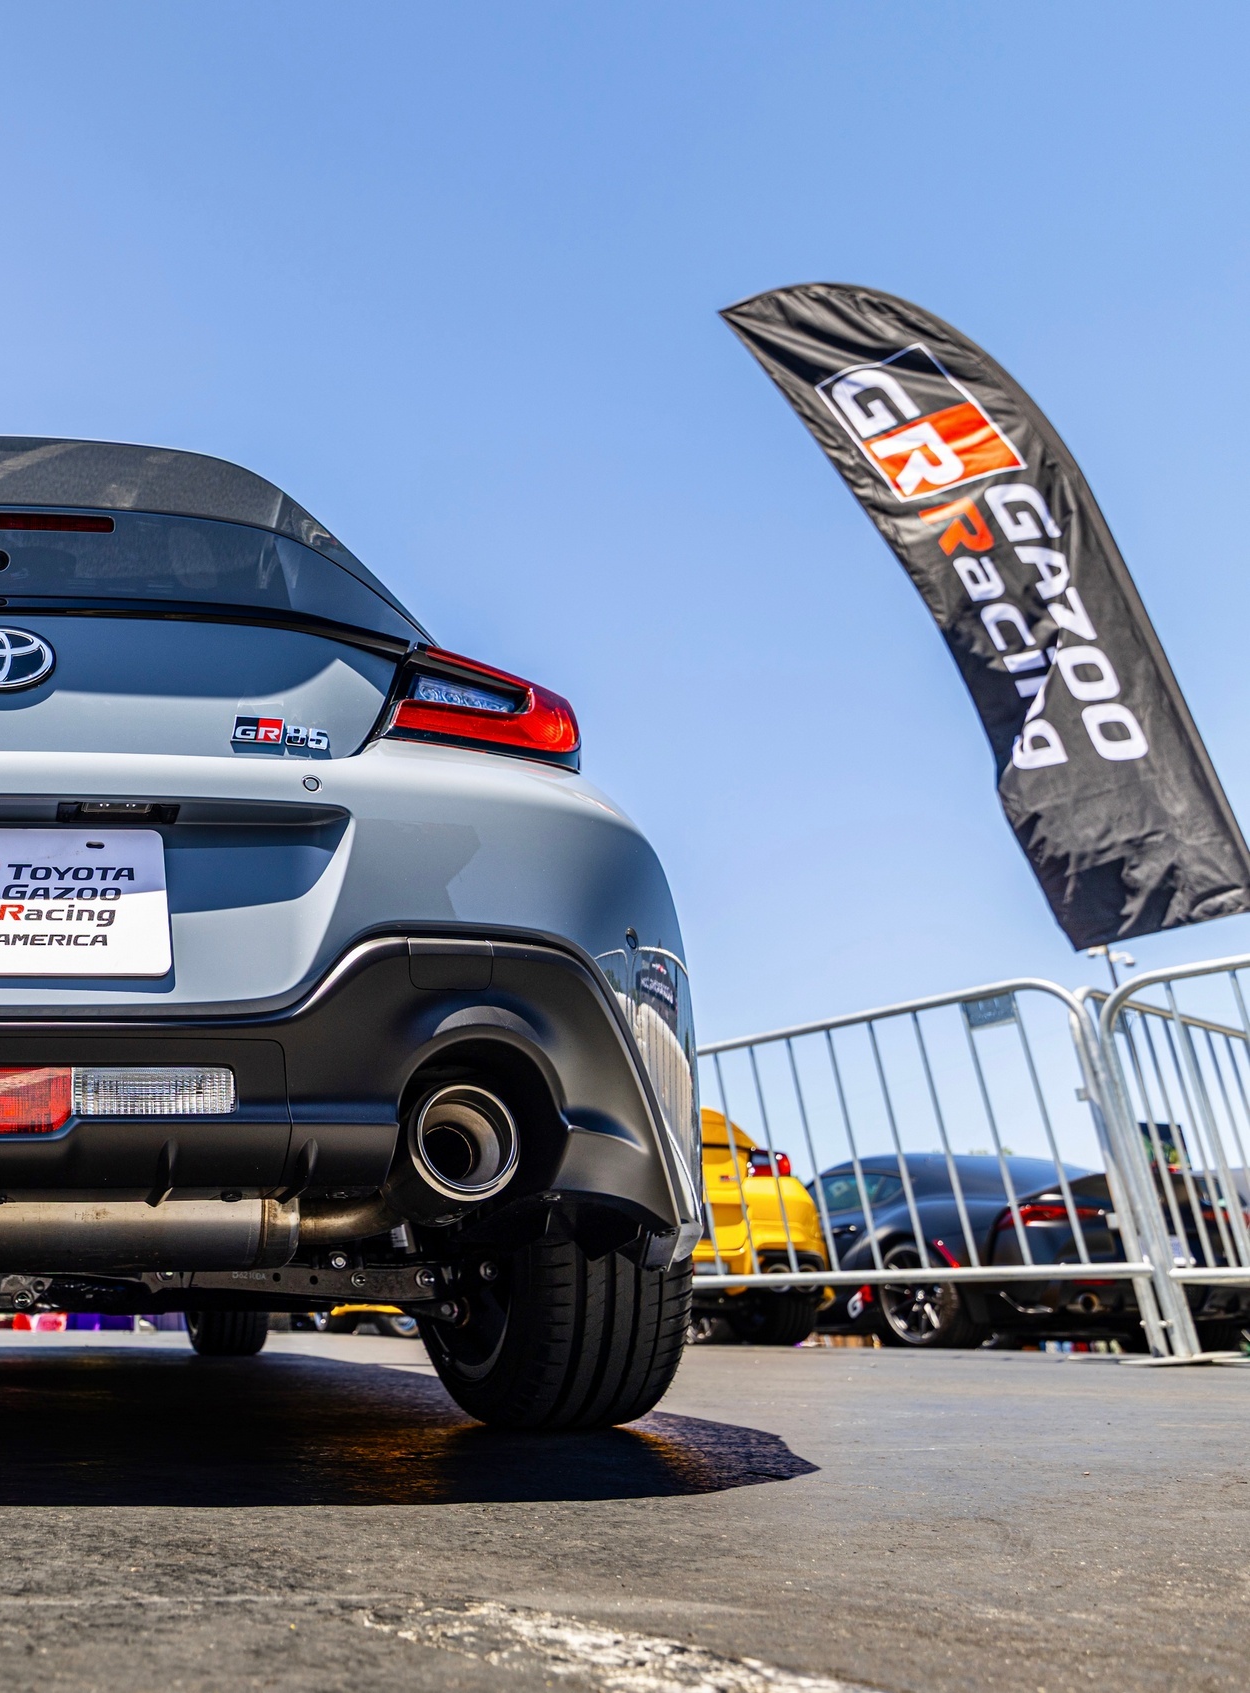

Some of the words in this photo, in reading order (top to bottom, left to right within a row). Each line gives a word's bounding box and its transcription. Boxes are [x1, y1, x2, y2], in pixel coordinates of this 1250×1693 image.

[831, 369, 965, 496] GR
[984, 483, 1149, 761] GAZOO
[2, 884, 122, 901] GAZOO
[7, 863, 135, 881] TOYOTA
